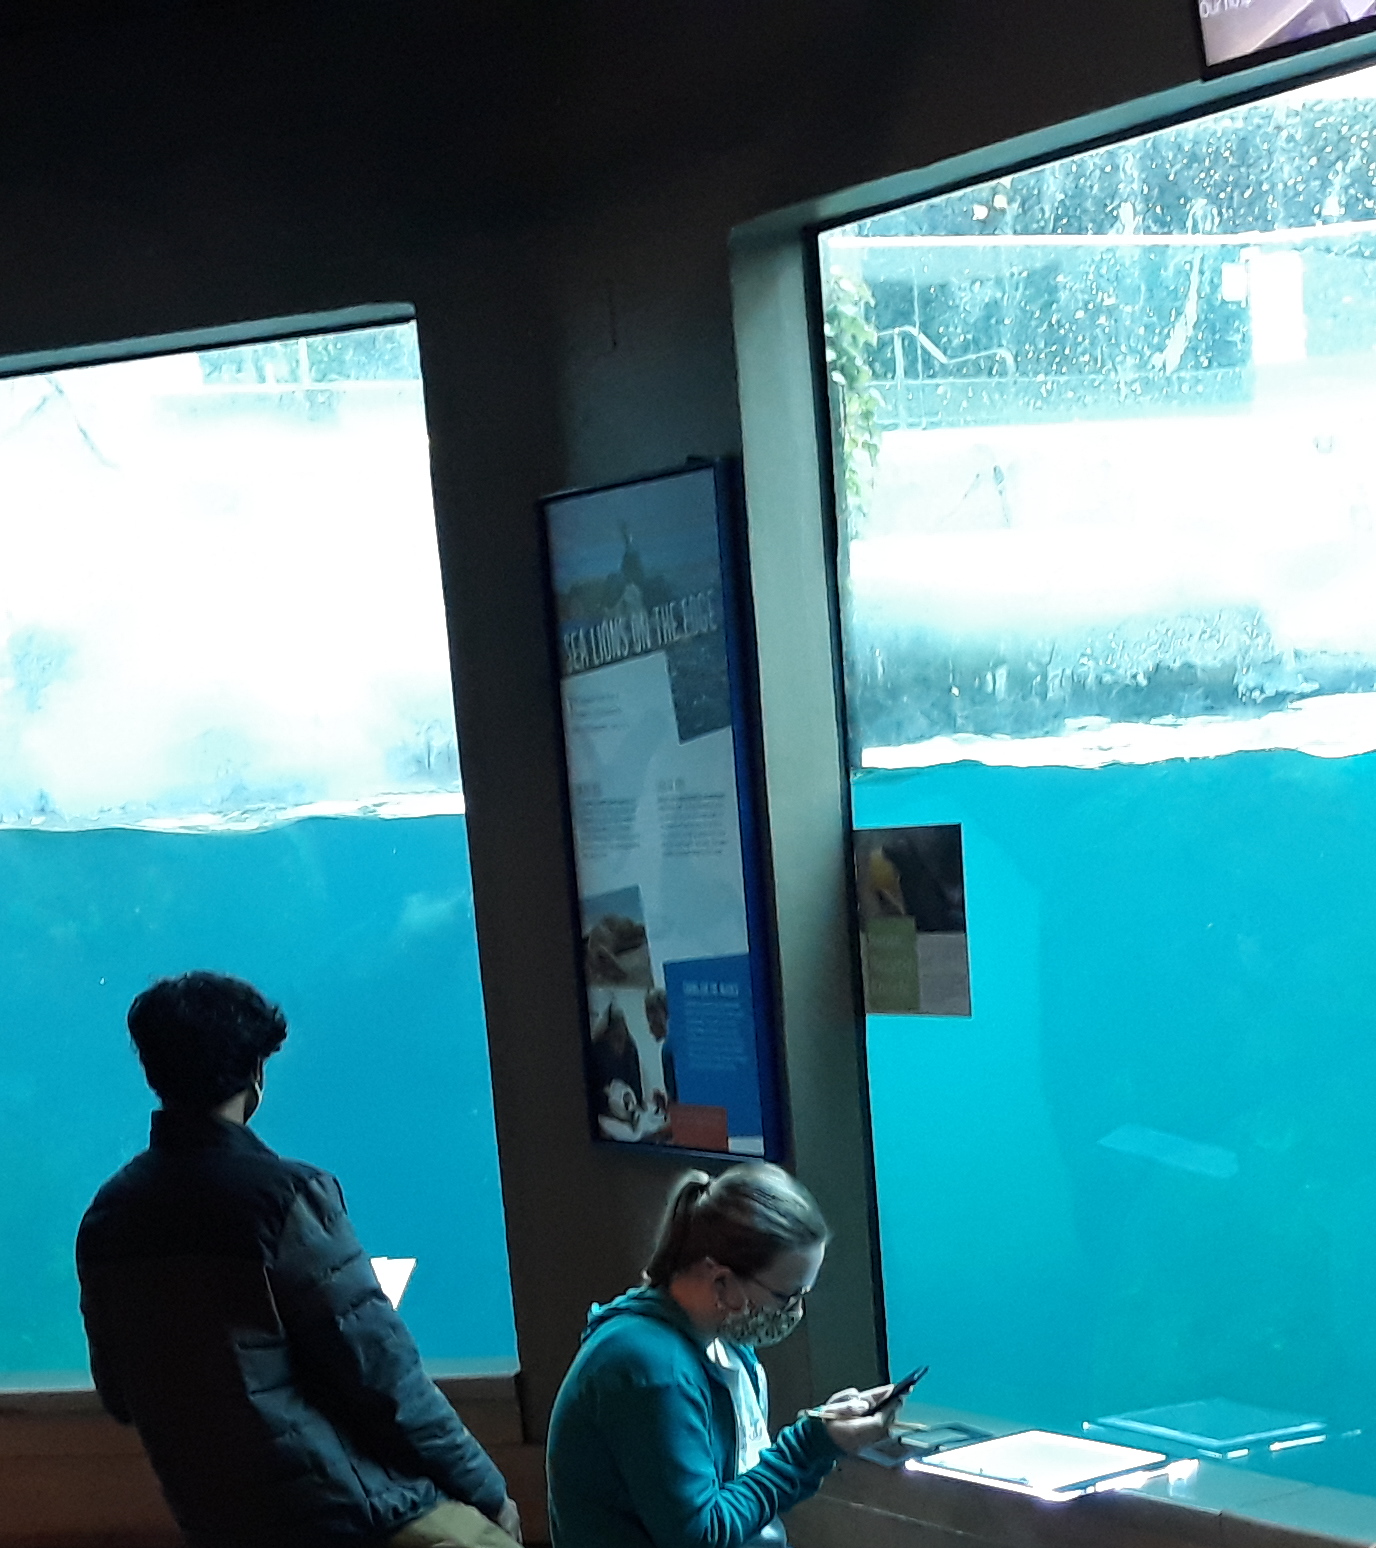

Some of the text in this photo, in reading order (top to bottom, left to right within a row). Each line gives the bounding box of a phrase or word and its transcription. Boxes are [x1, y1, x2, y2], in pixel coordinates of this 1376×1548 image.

[563, 588, 718, 674] SEA LIONS ON THE EDGE
